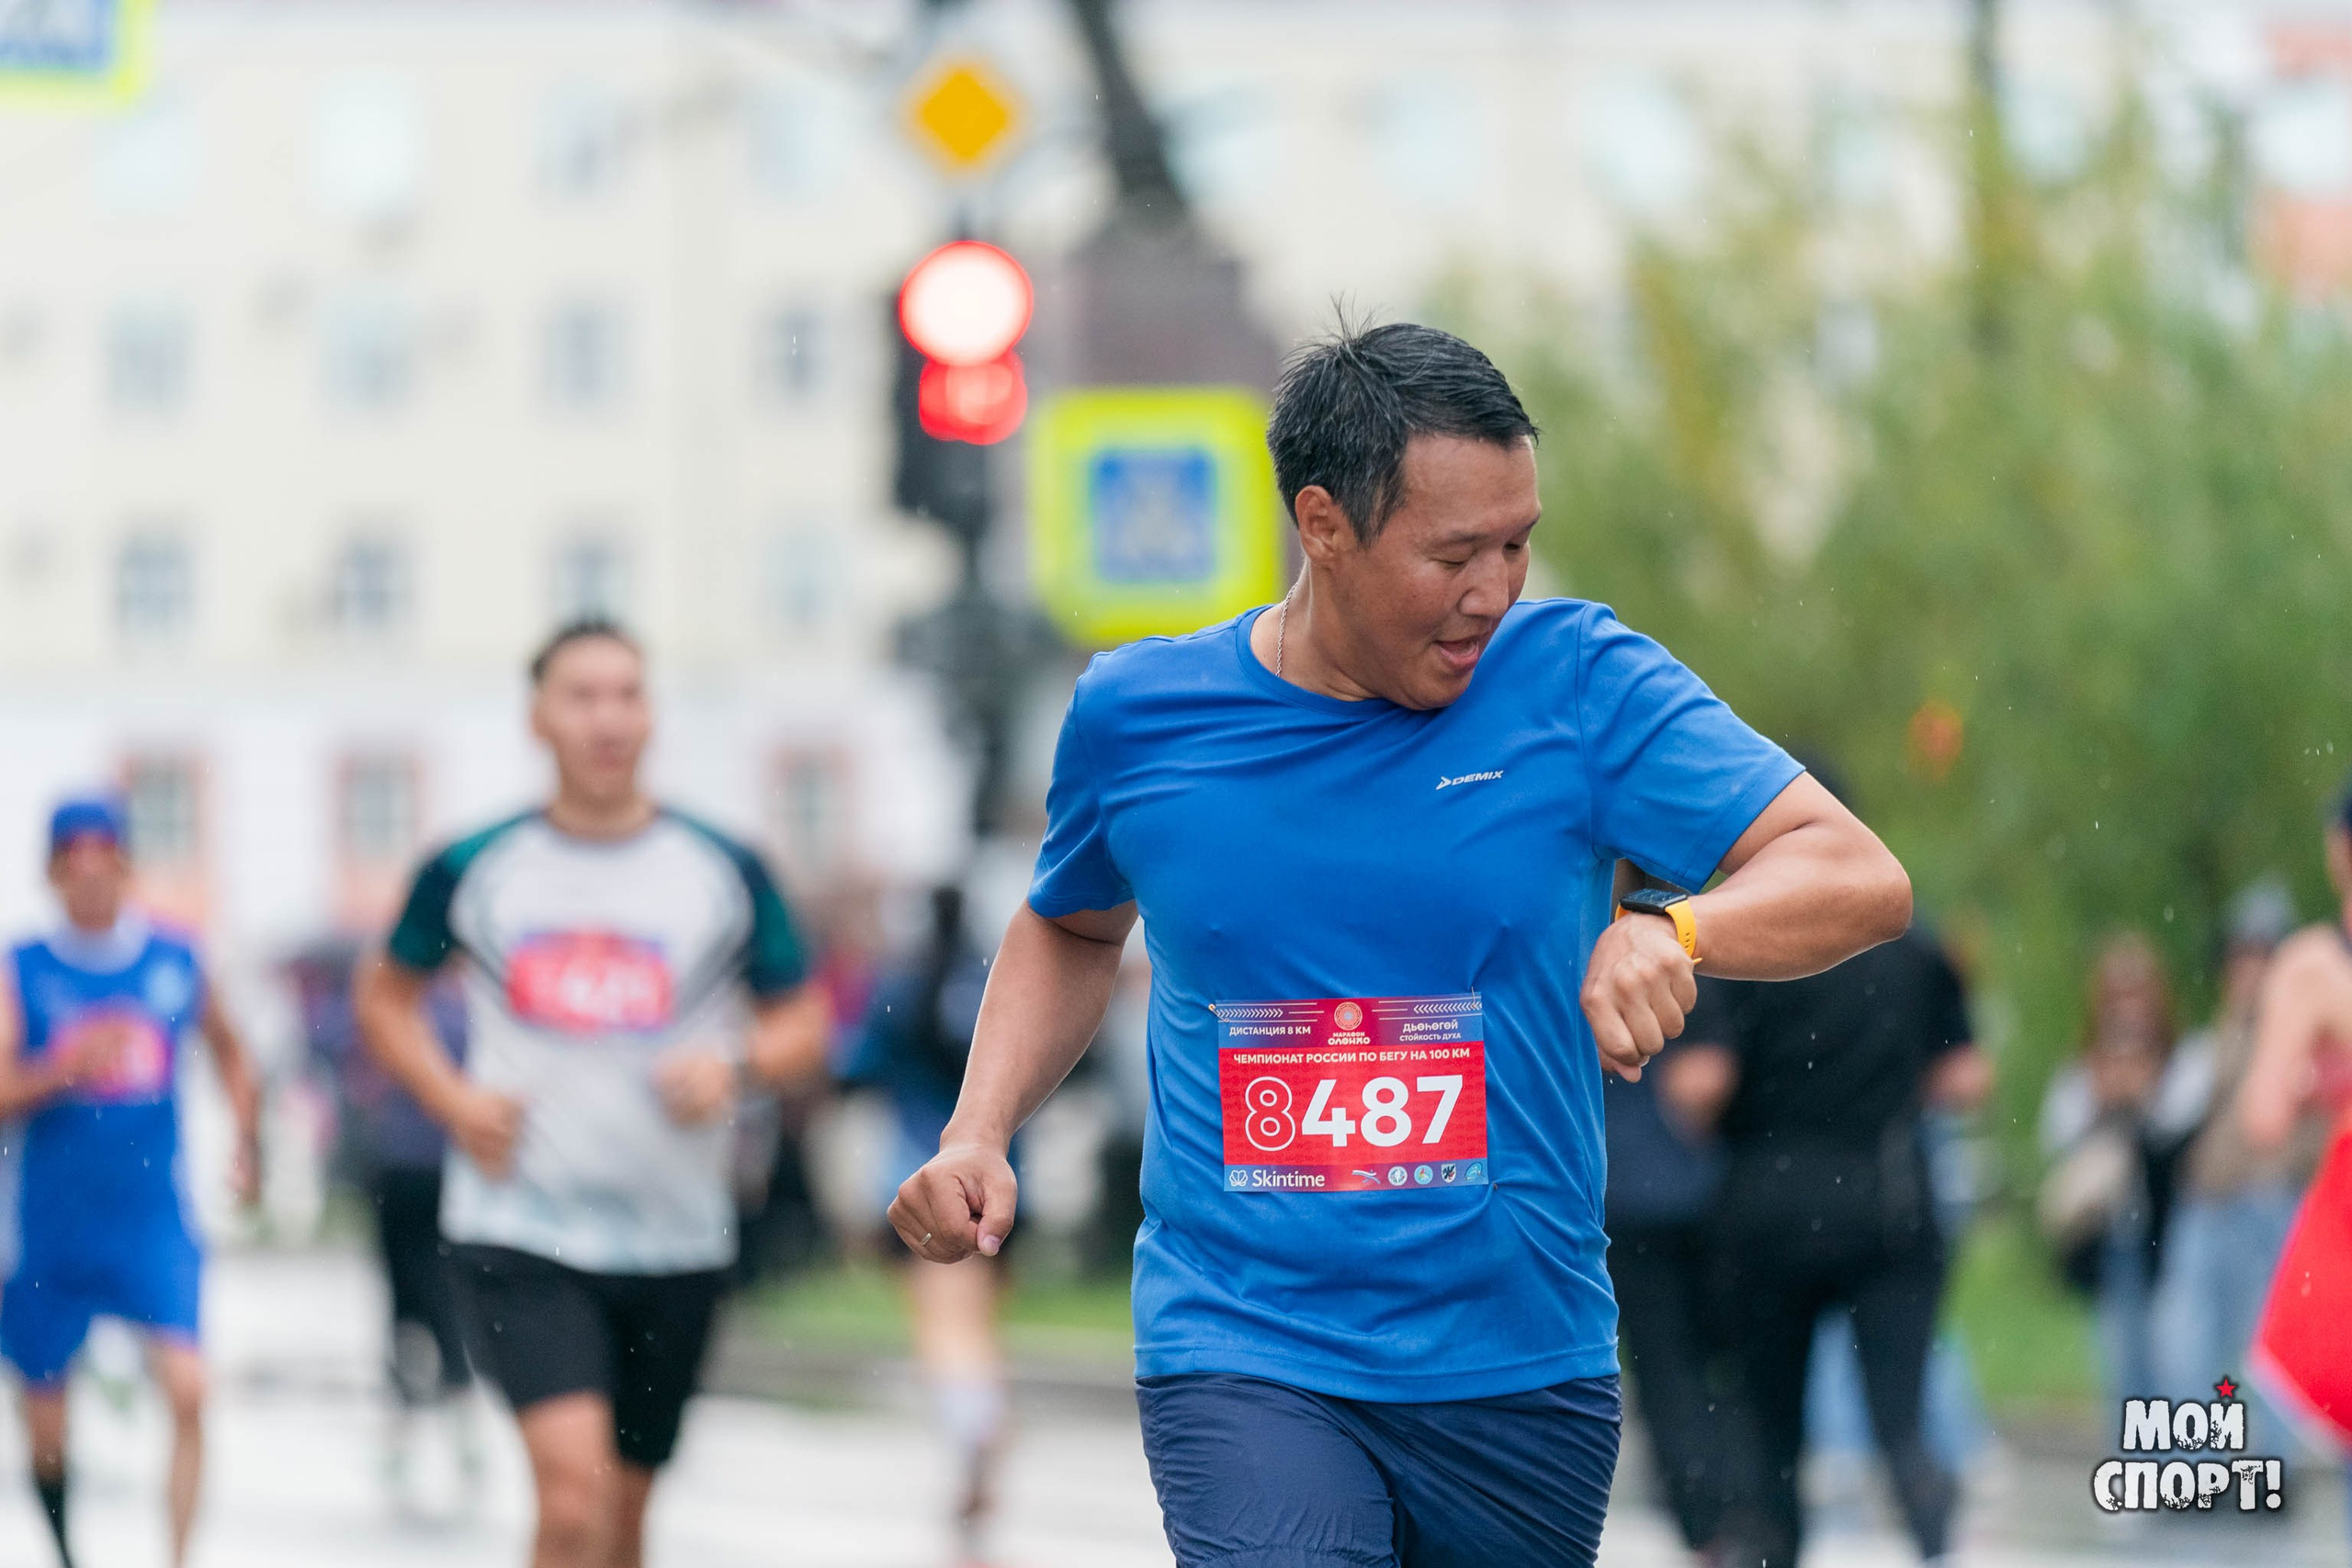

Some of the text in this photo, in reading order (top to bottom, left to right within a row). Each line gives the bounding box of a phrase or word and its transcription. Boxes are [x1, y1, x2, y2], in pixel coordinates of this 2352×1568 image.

[1452, 770, 1504, 785] DEMIX
[1229, 1026, 1311, 1036] ДИСТАНЦИЯ 8 КМ
[1399, 1032, 1462, 1042] СТОЙКОСТЬ ДУХА
[1234, 1048, 1470, 1064] ЧЕМПИОНАТ РОССИИ ПО БЕГУ НА 100 КМ
[1245, 1074, 1464, 1152] 8487
[1252, 1169, 1325, 1188] Skintime
